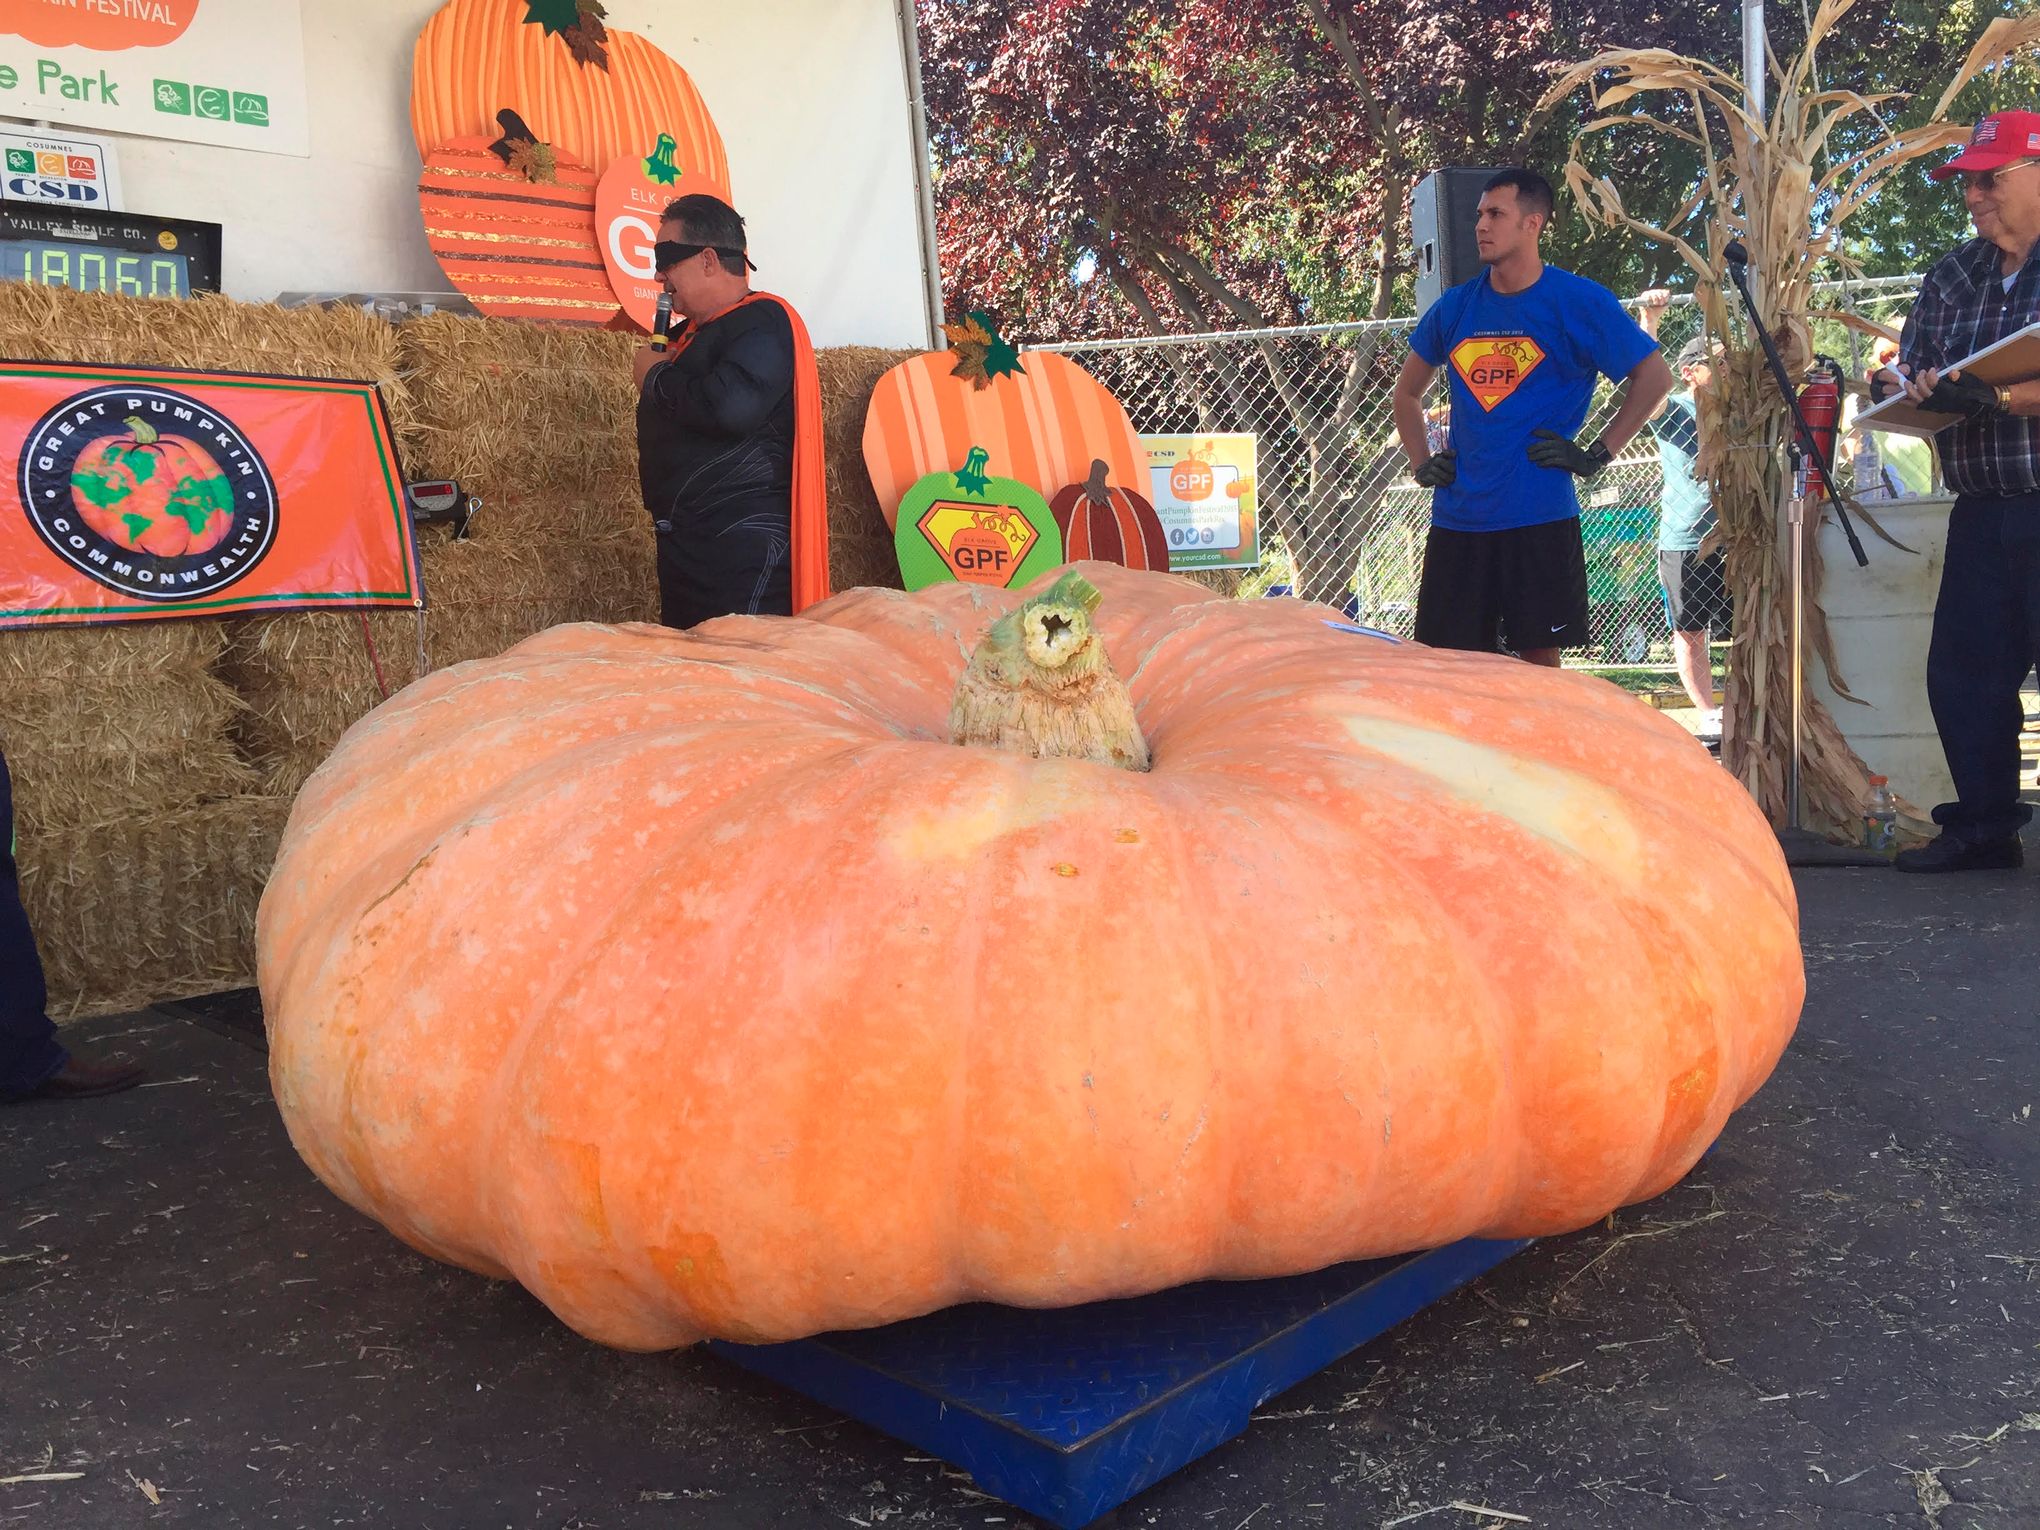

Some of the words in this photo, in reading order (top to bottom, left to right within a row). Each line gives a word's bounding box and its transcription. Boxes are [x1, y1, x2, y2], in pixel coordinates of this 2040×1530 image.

[37, 59, 120, 106] Park
[26, 141, 73, 153] COSUMNES
[9, 178, 98, 202] CSD
[631, 188, 657, 205] ELK
[9, 218, 63, 232] VALLEY
[72, 224, 116, 238] SCALE
[123, 228, 148, 240] CO.
[1471, 368, 1516, 385] GPF
[38, 401, 106, 472] GREAT
[127, 398, 255, 476] PUMPKIN
[1173, 473, 1212, 491] GPF
[53, 516, 262, 585] COMMONWEALTH
[954, 547, 1008, 571] GPF
